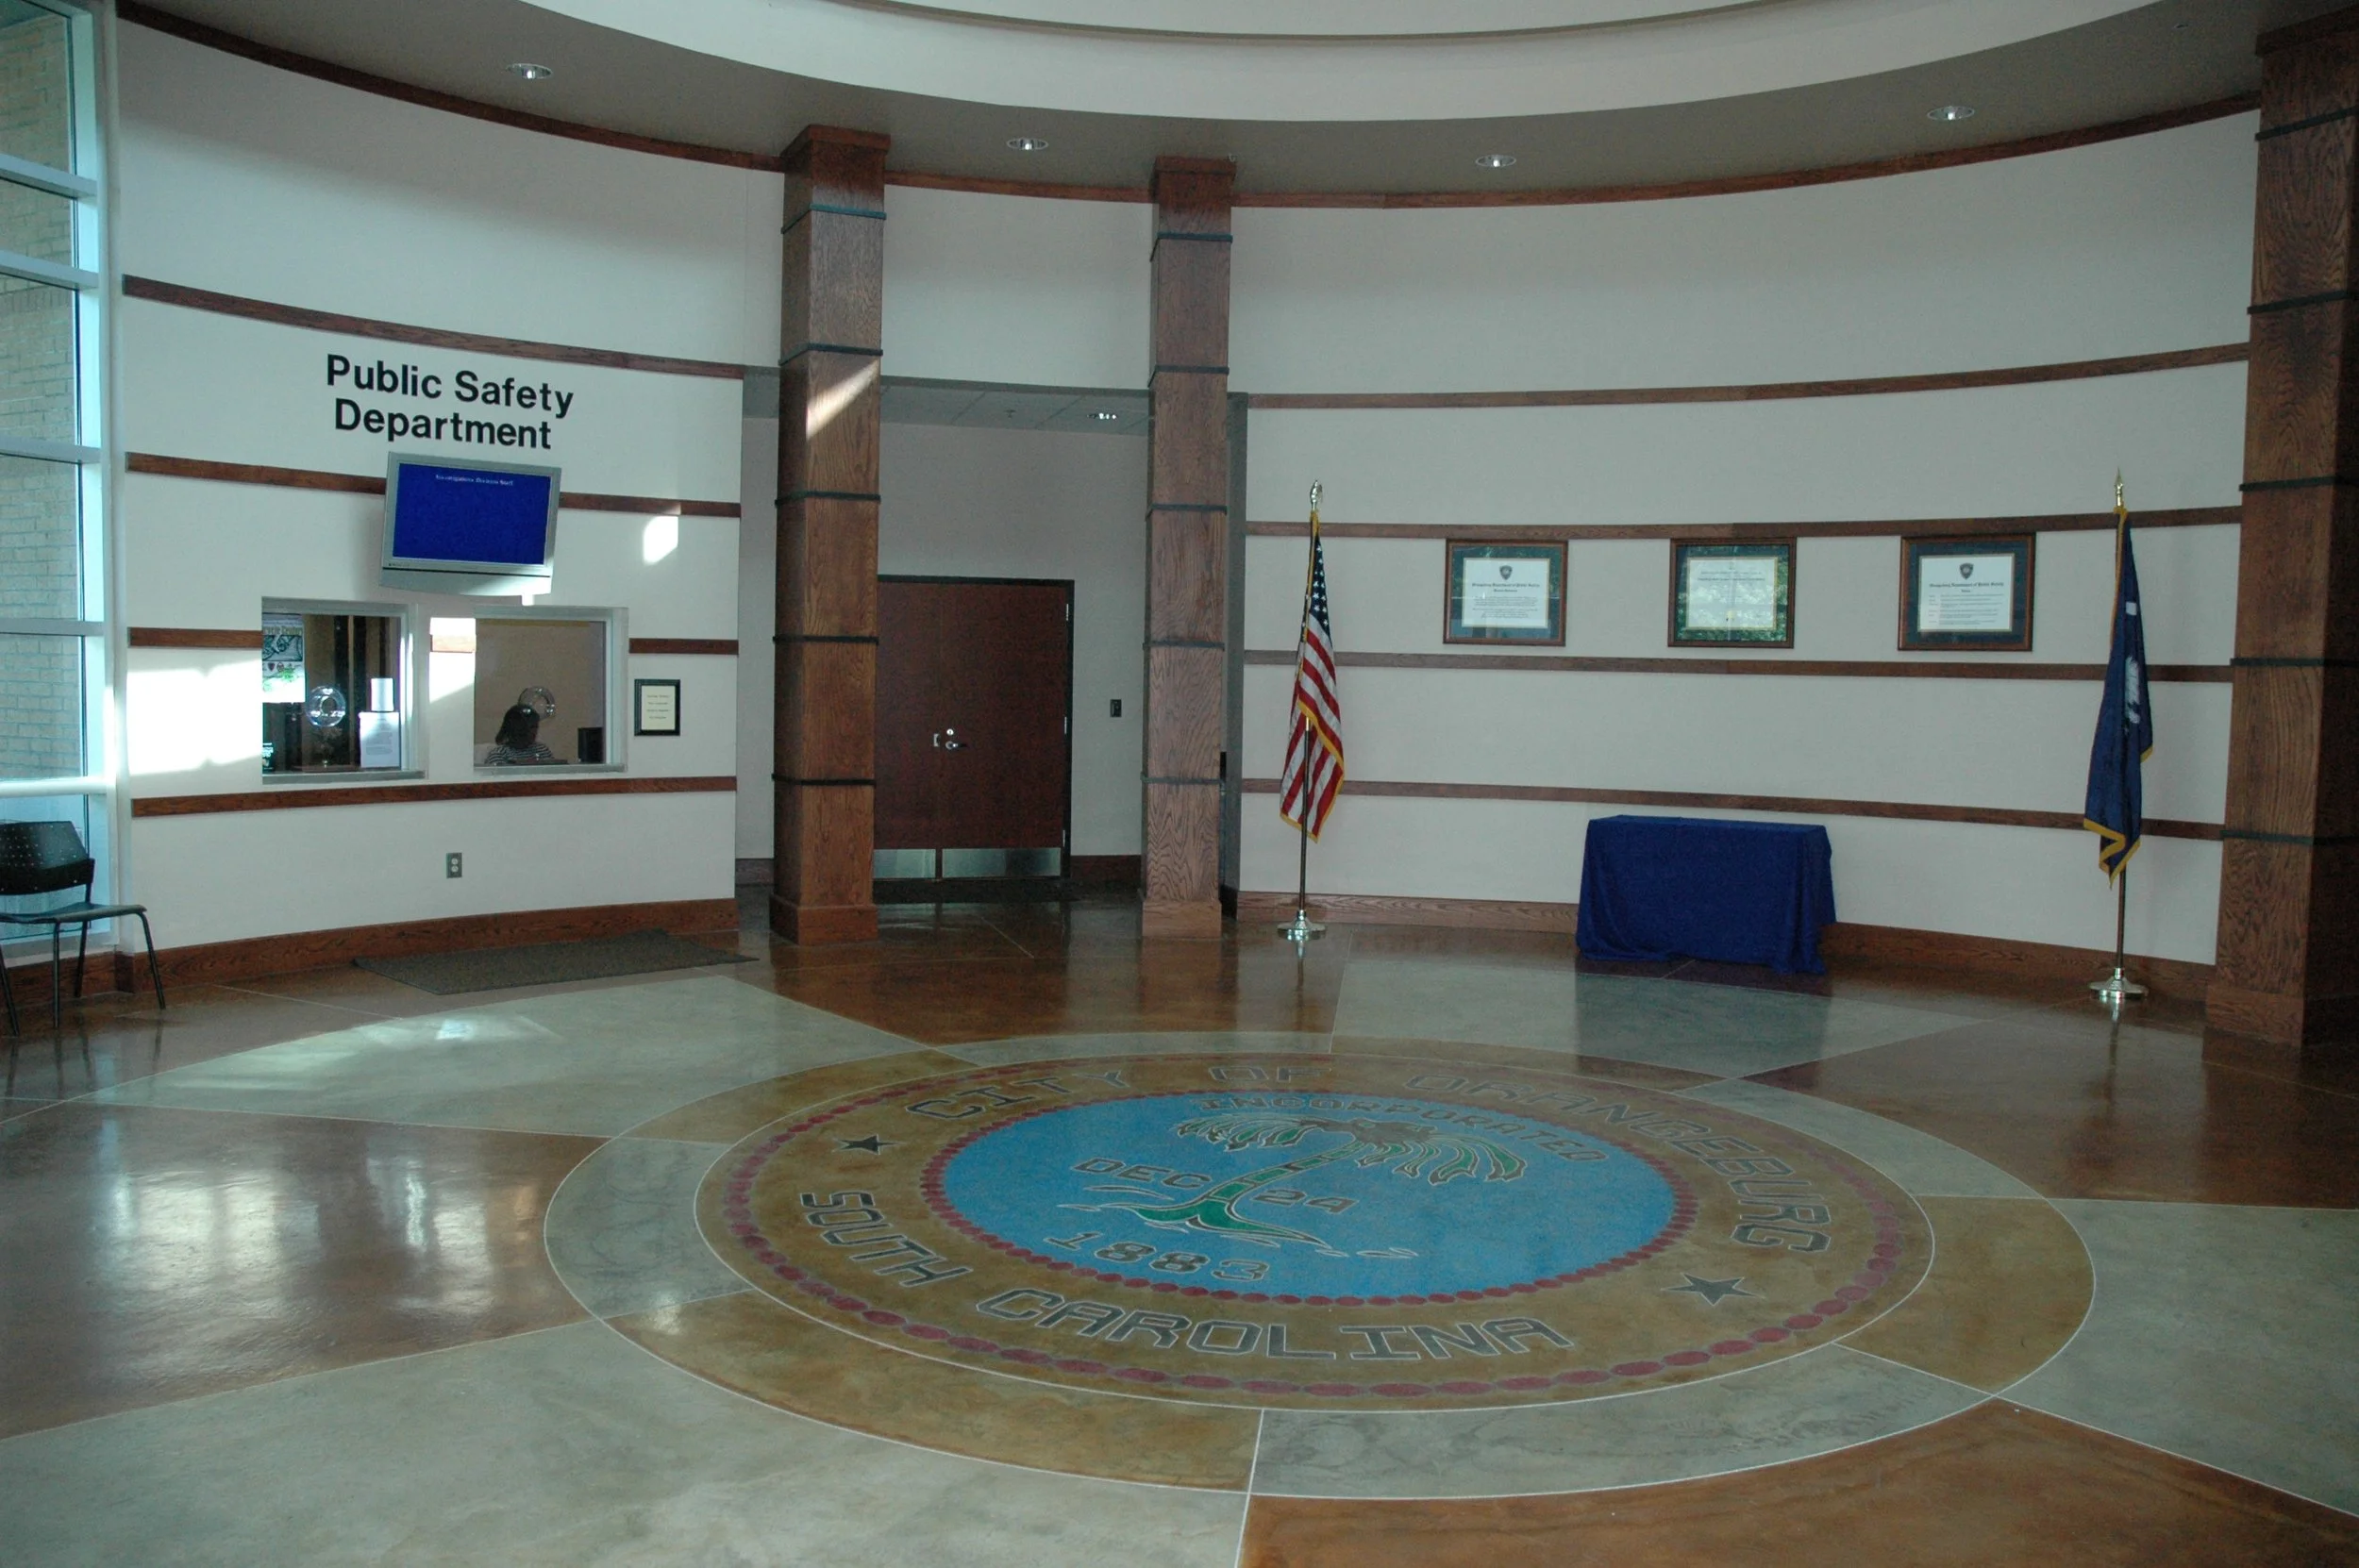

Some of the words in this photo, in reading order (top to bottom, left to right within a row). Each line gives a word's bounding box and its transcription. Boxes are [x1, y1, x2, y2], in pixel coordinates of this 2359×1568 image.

[327, 354, 442, 399] Public
[455, 370, 574, 419] Safety
[335, 397, 551, 449] Department
[905, 1070, 1129, 1119] CITY
[1208, 1066, 1332, 1083] OF
[1403, 1074, 1832, 1252] ORANGEBURG
[1198, 1095, 1608, 1162] INCORPORATED
[1070, 1157, 1213, 1189] DEC
[1250, 1189, 1360, 1214] 24
[800, 1191, 974, 1288] SOUTH
[976, 1288, 1574, 1360] CAROLINA
[1043, 1230, 1269, 1281] 1883
